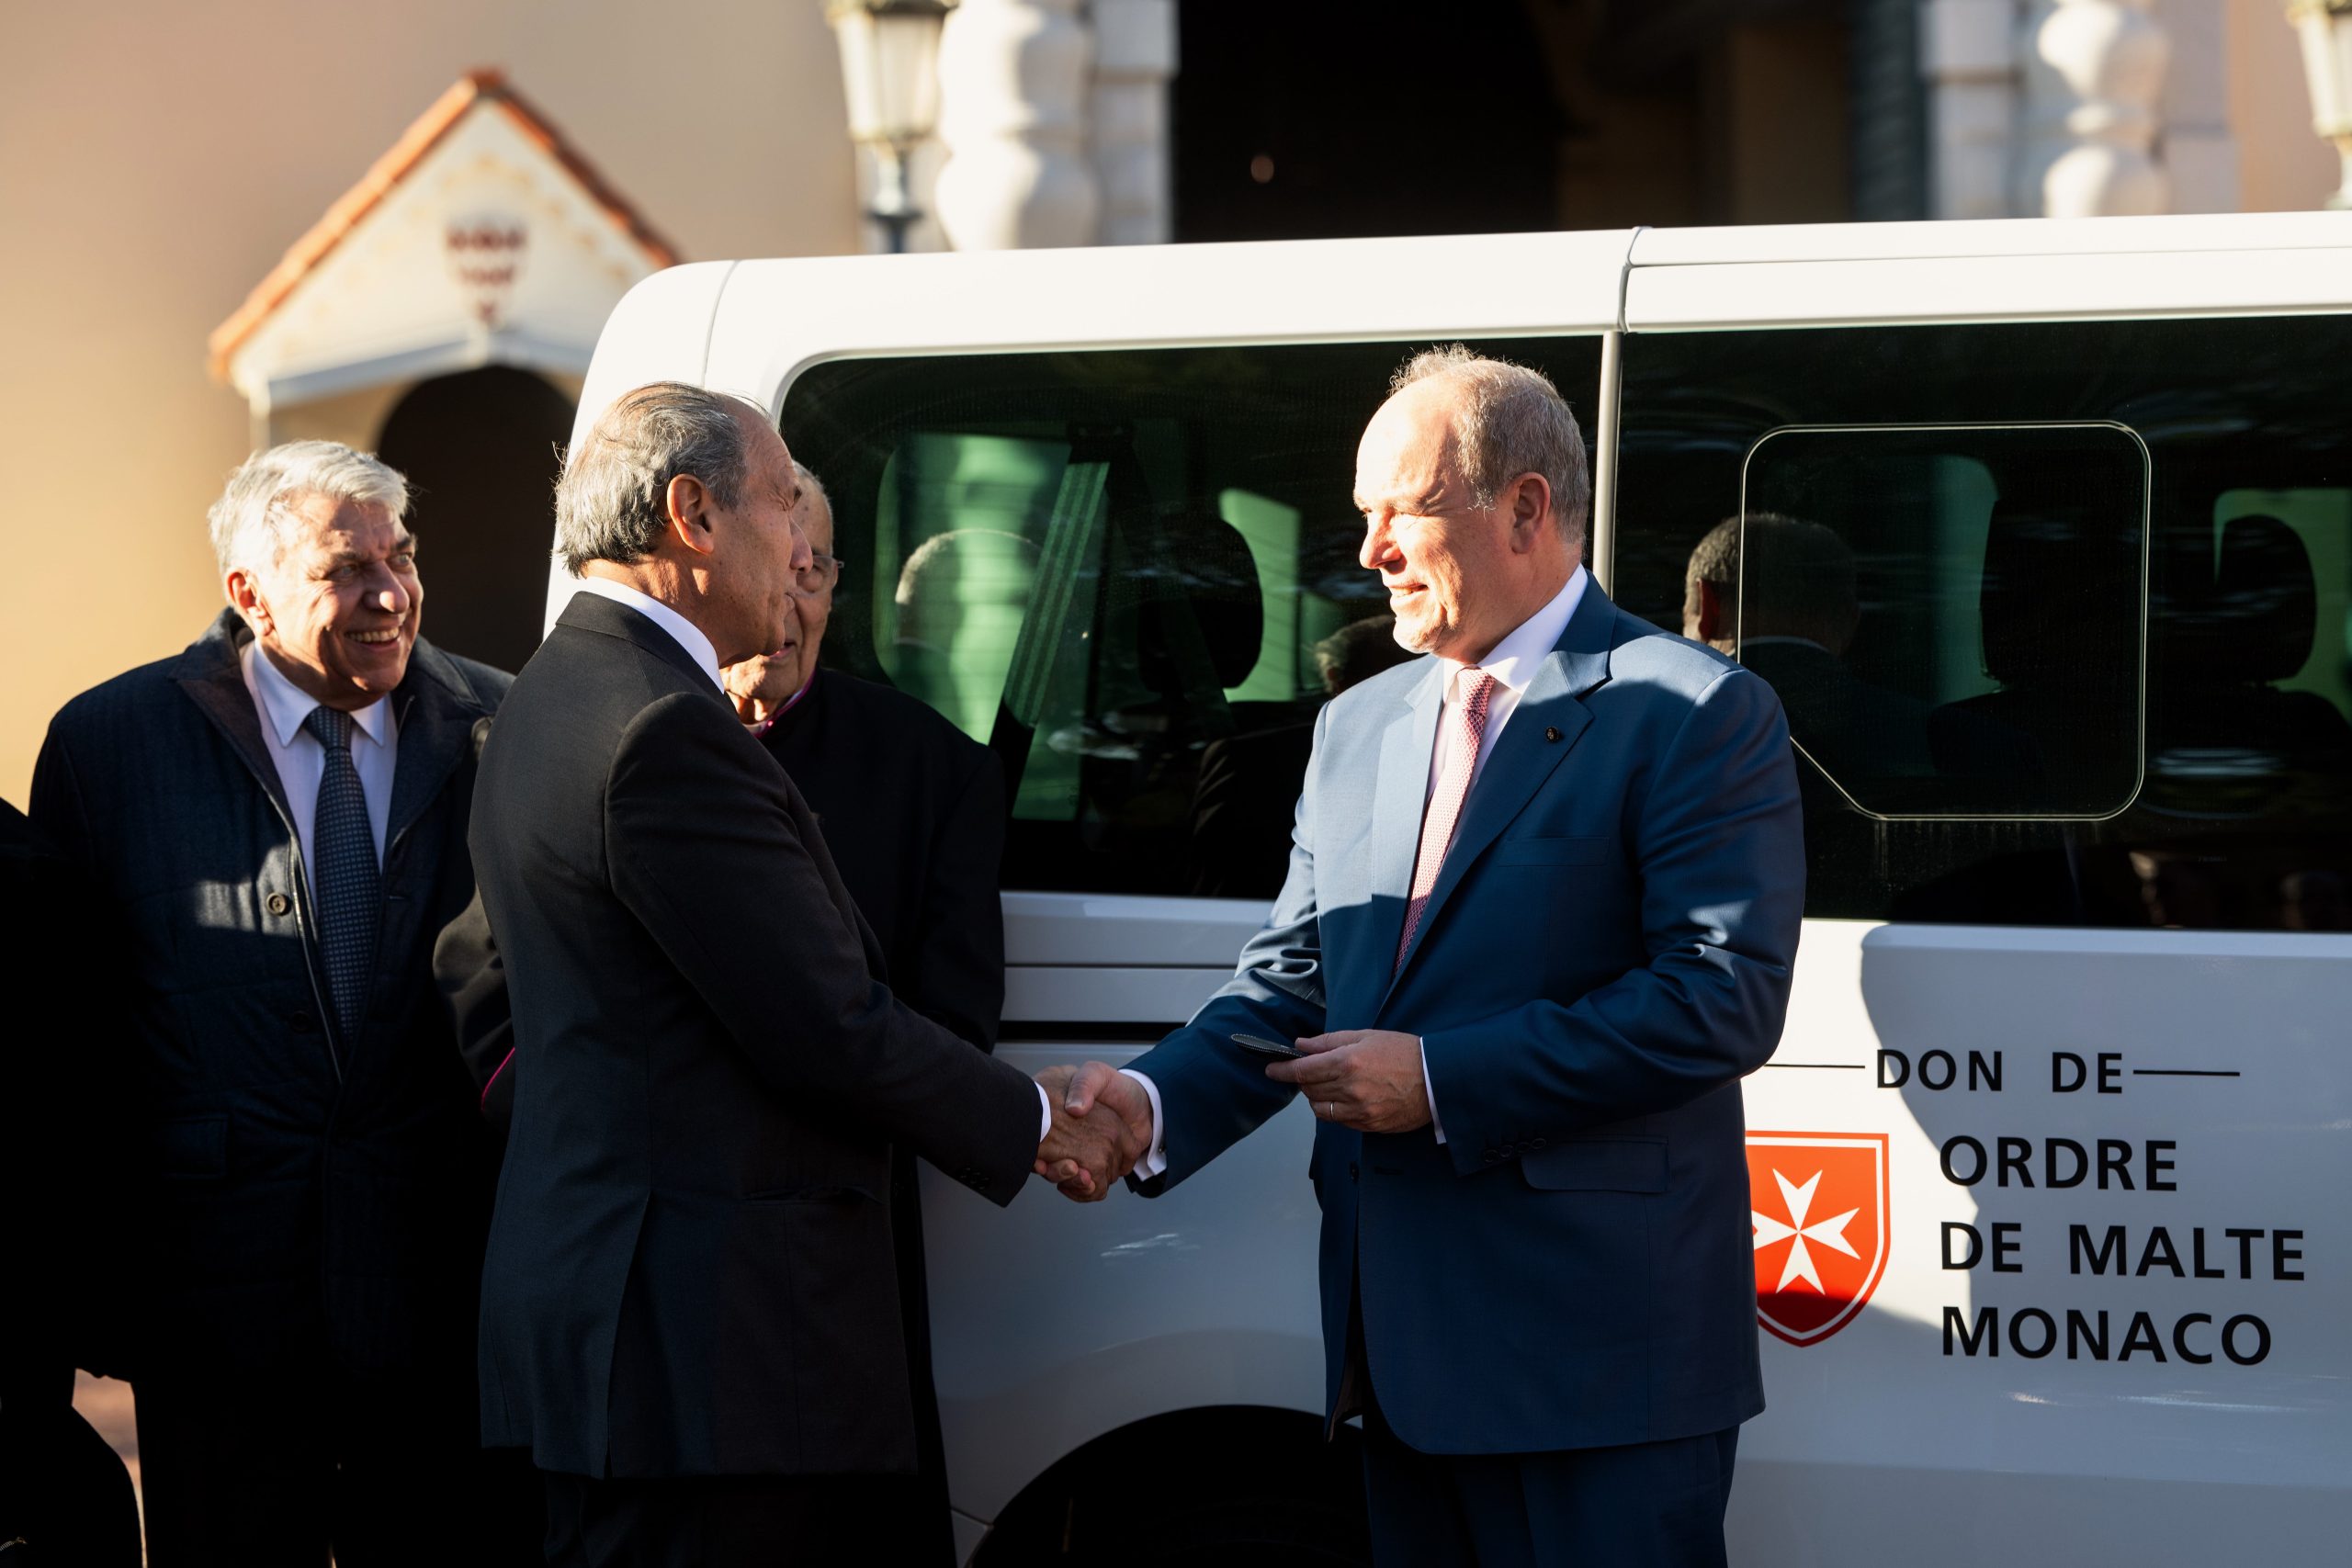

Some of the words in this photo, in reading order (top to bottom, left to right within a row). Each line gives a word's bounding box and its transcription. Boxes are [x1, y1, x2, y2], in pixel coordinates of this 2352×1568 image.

[1877, 1048, 2003, 1092] DON
[2052, 1051, 2123, 1094] DE
[1939, 1134, 2177, 1192] ORDRE
[1940, 1222, 2024, 1273] DE
[2069, 1224, 2305, 1281] MALTE
[1942, 1306, 2272, 1367] MONACO
